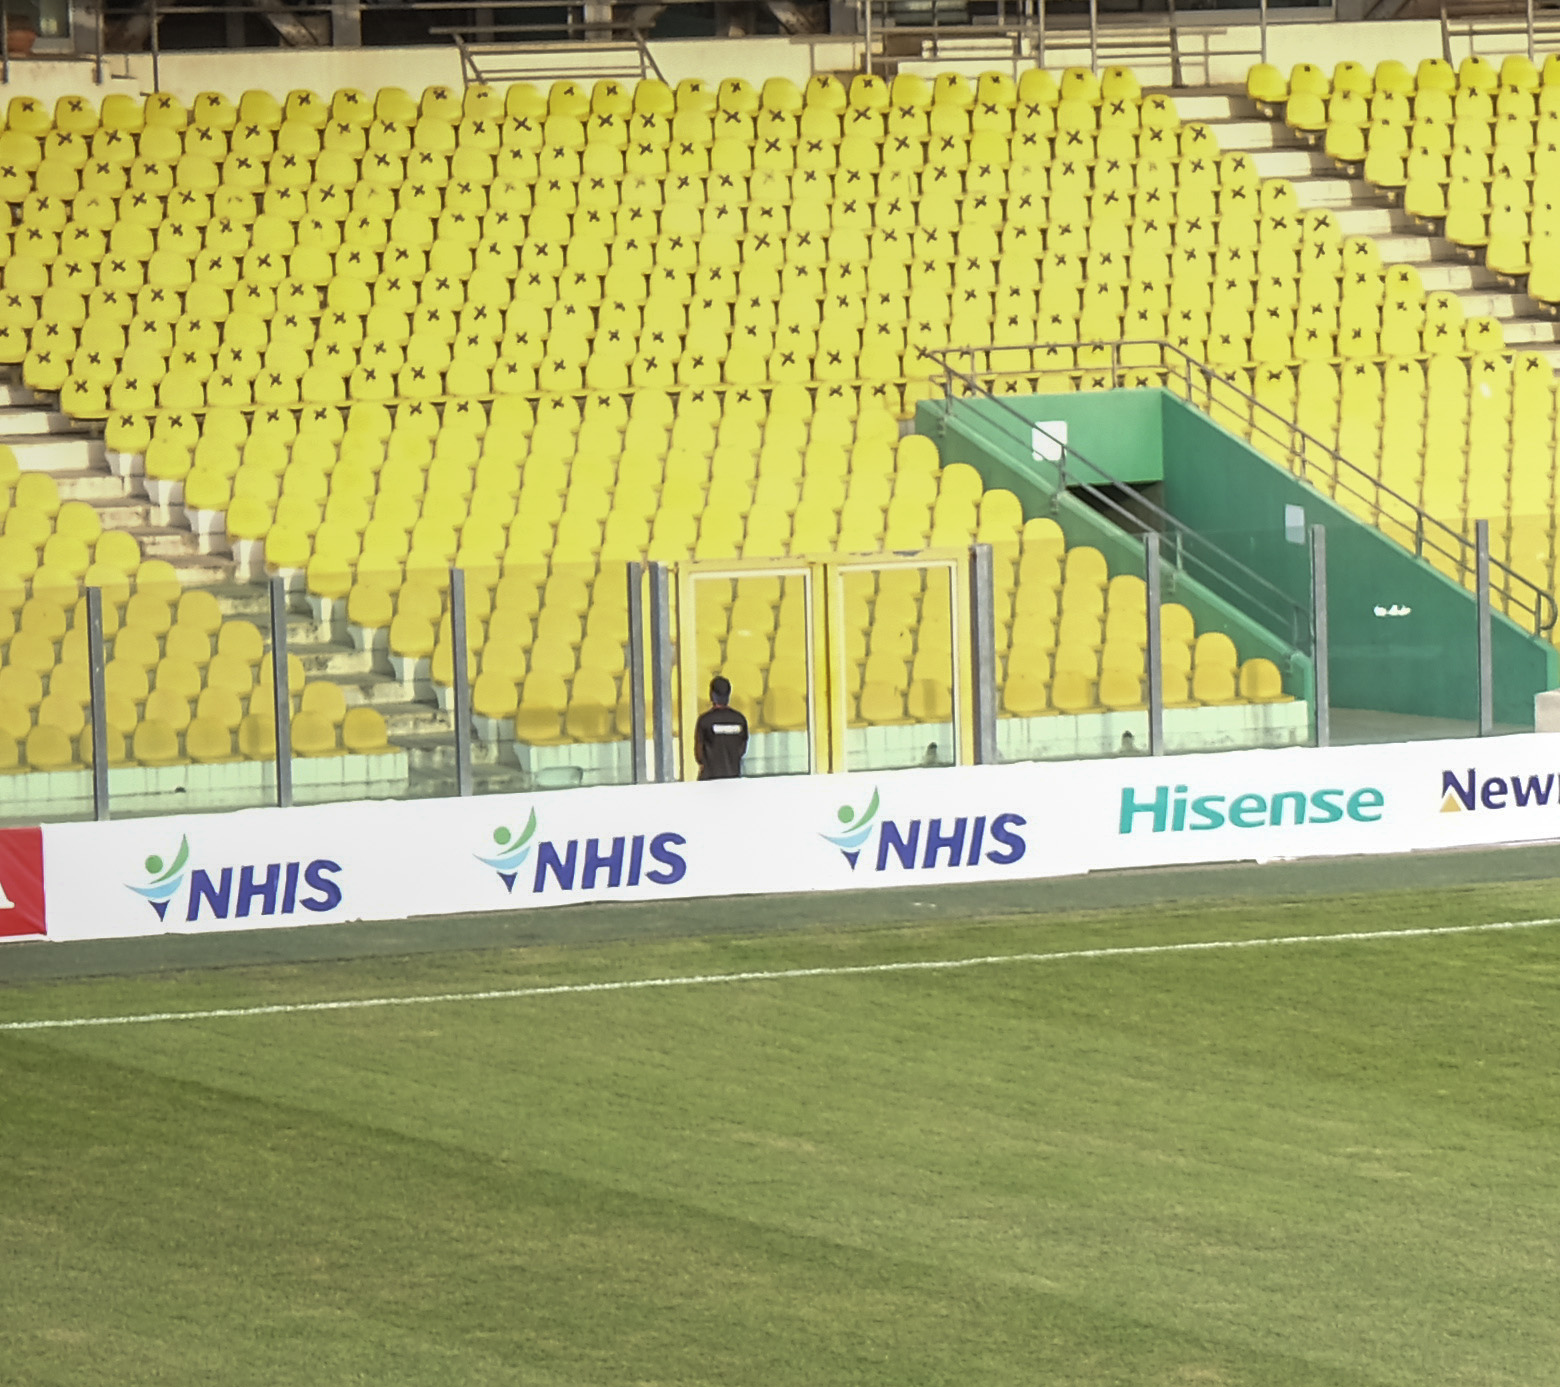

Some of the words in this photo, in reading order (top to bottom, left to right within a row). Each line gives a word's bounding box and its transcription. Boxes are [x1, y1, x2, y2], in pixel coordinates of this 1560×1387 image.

[1118, 784, 1385, 835] Hisense
[533, 831, 687, 893] NHIS
[876, 813, 1026, 870] NHIS
[186, 859, 343, 921] NHIS
